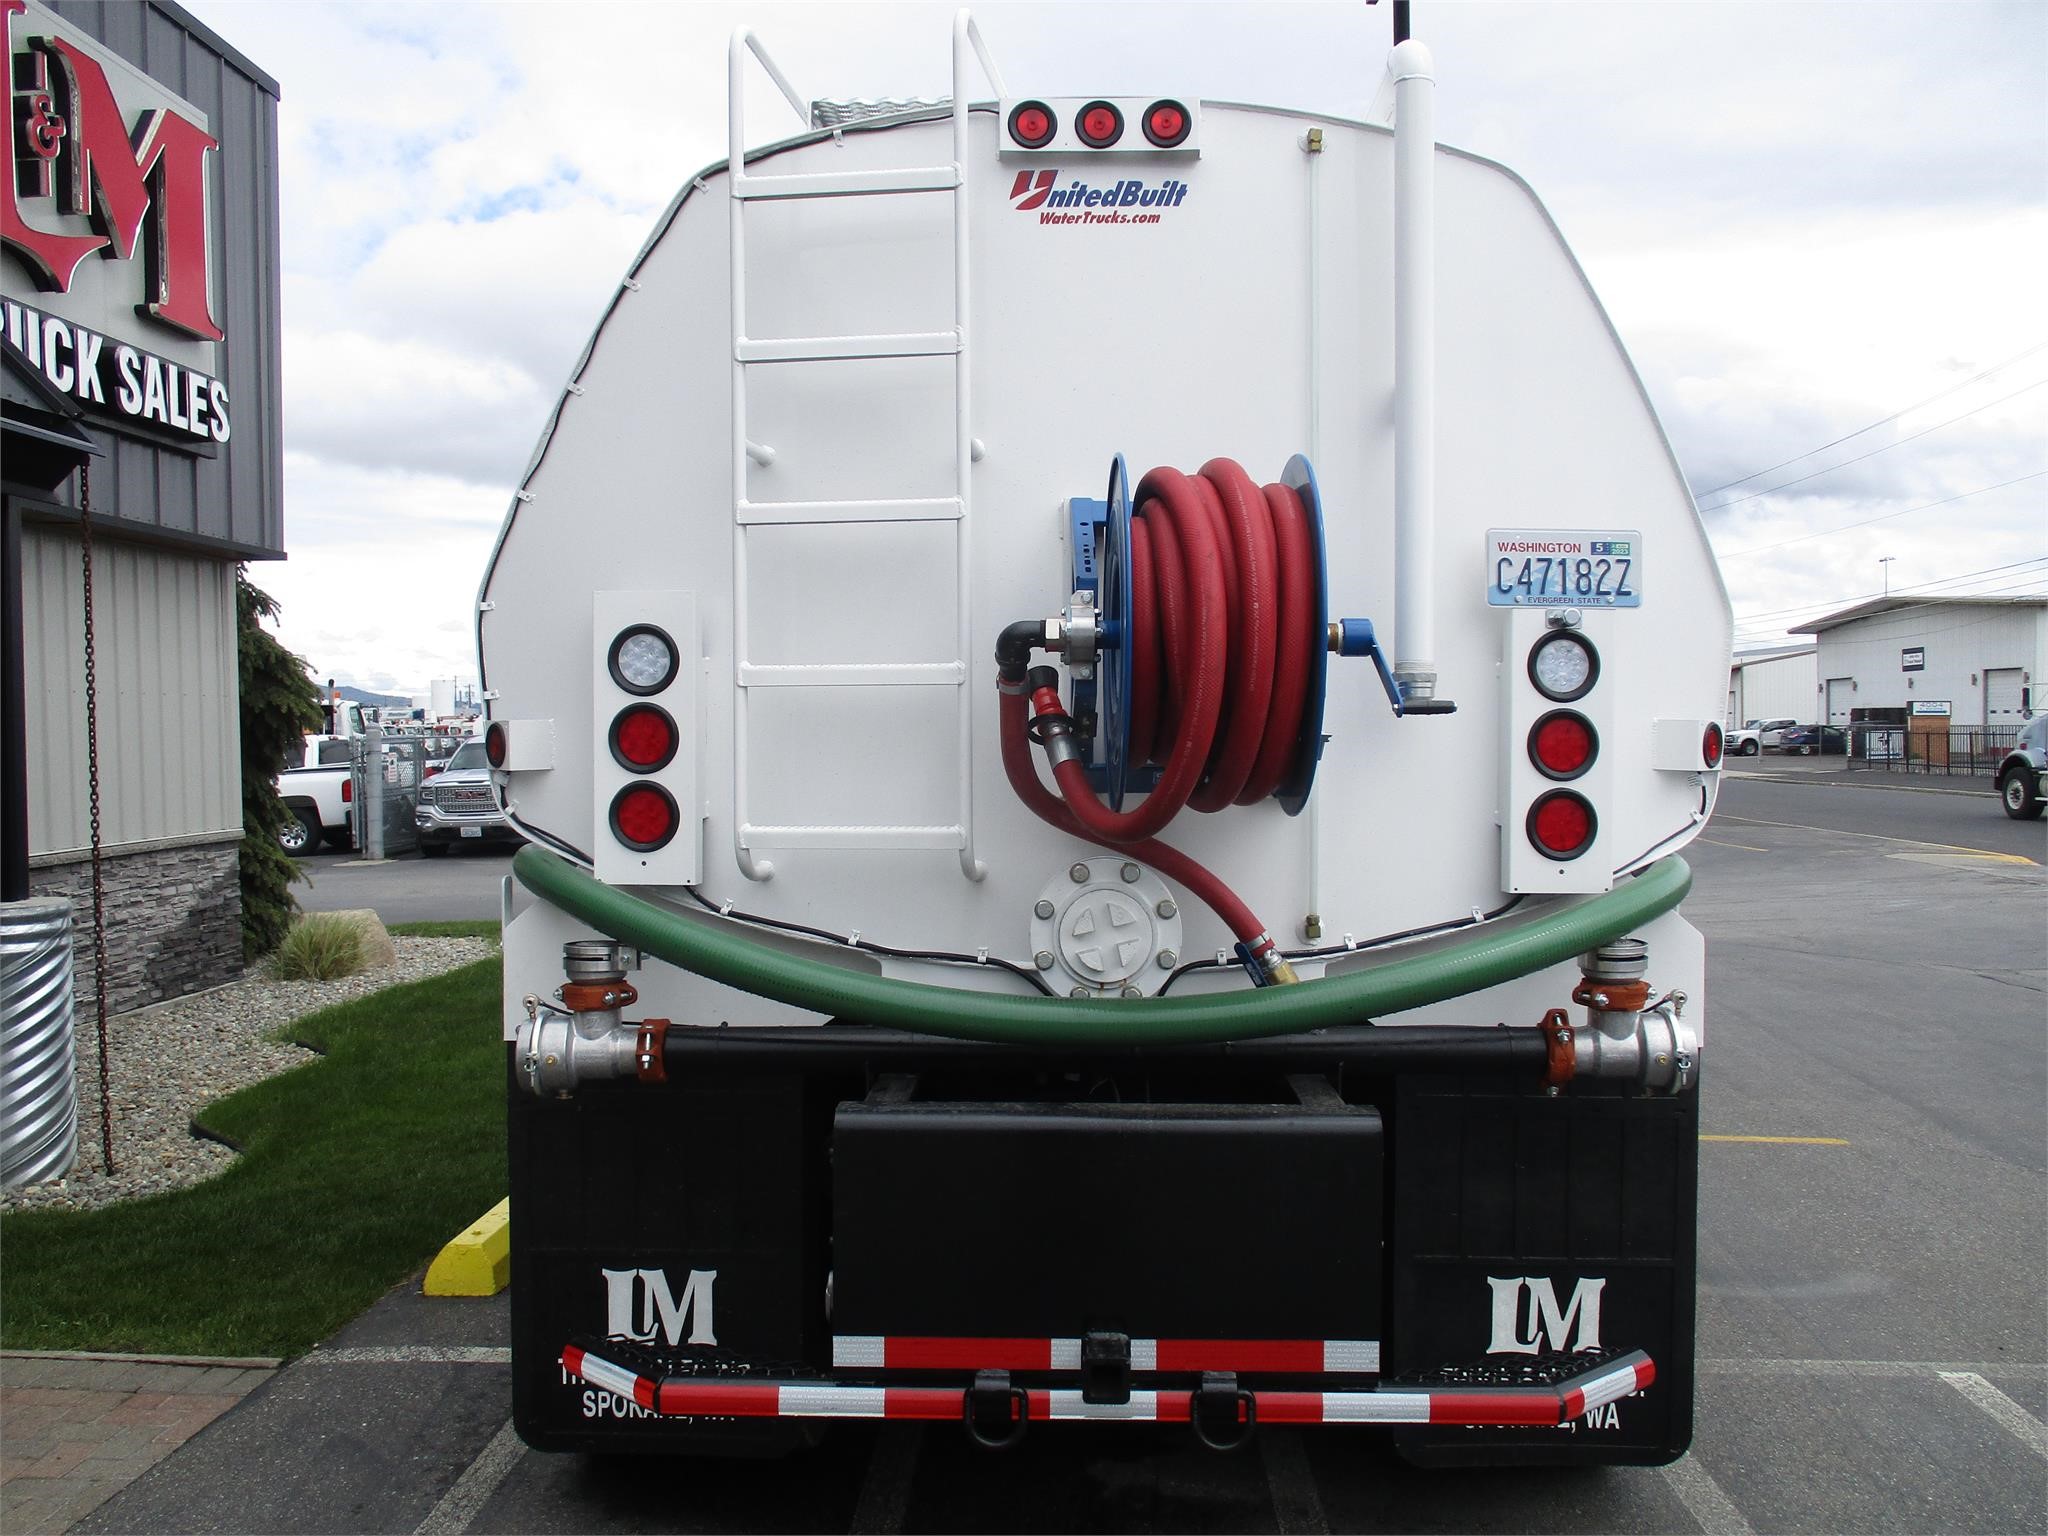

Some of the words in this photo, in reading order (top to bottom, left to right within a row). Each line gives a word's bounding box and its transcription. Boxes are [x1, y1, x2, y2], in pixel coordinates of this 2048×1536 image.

[1009, 169, 1188, 210] UnitedBuilt
[1039, 211, 1161, 225] WaterTrucks.com
[115, 345, 231, 443] SALES
[1498, 542, 1582, 553] WASHINGTON
[1497, 557, 1632, 596] C47182Z
[1586, 1402, 1620, 1430] WA
